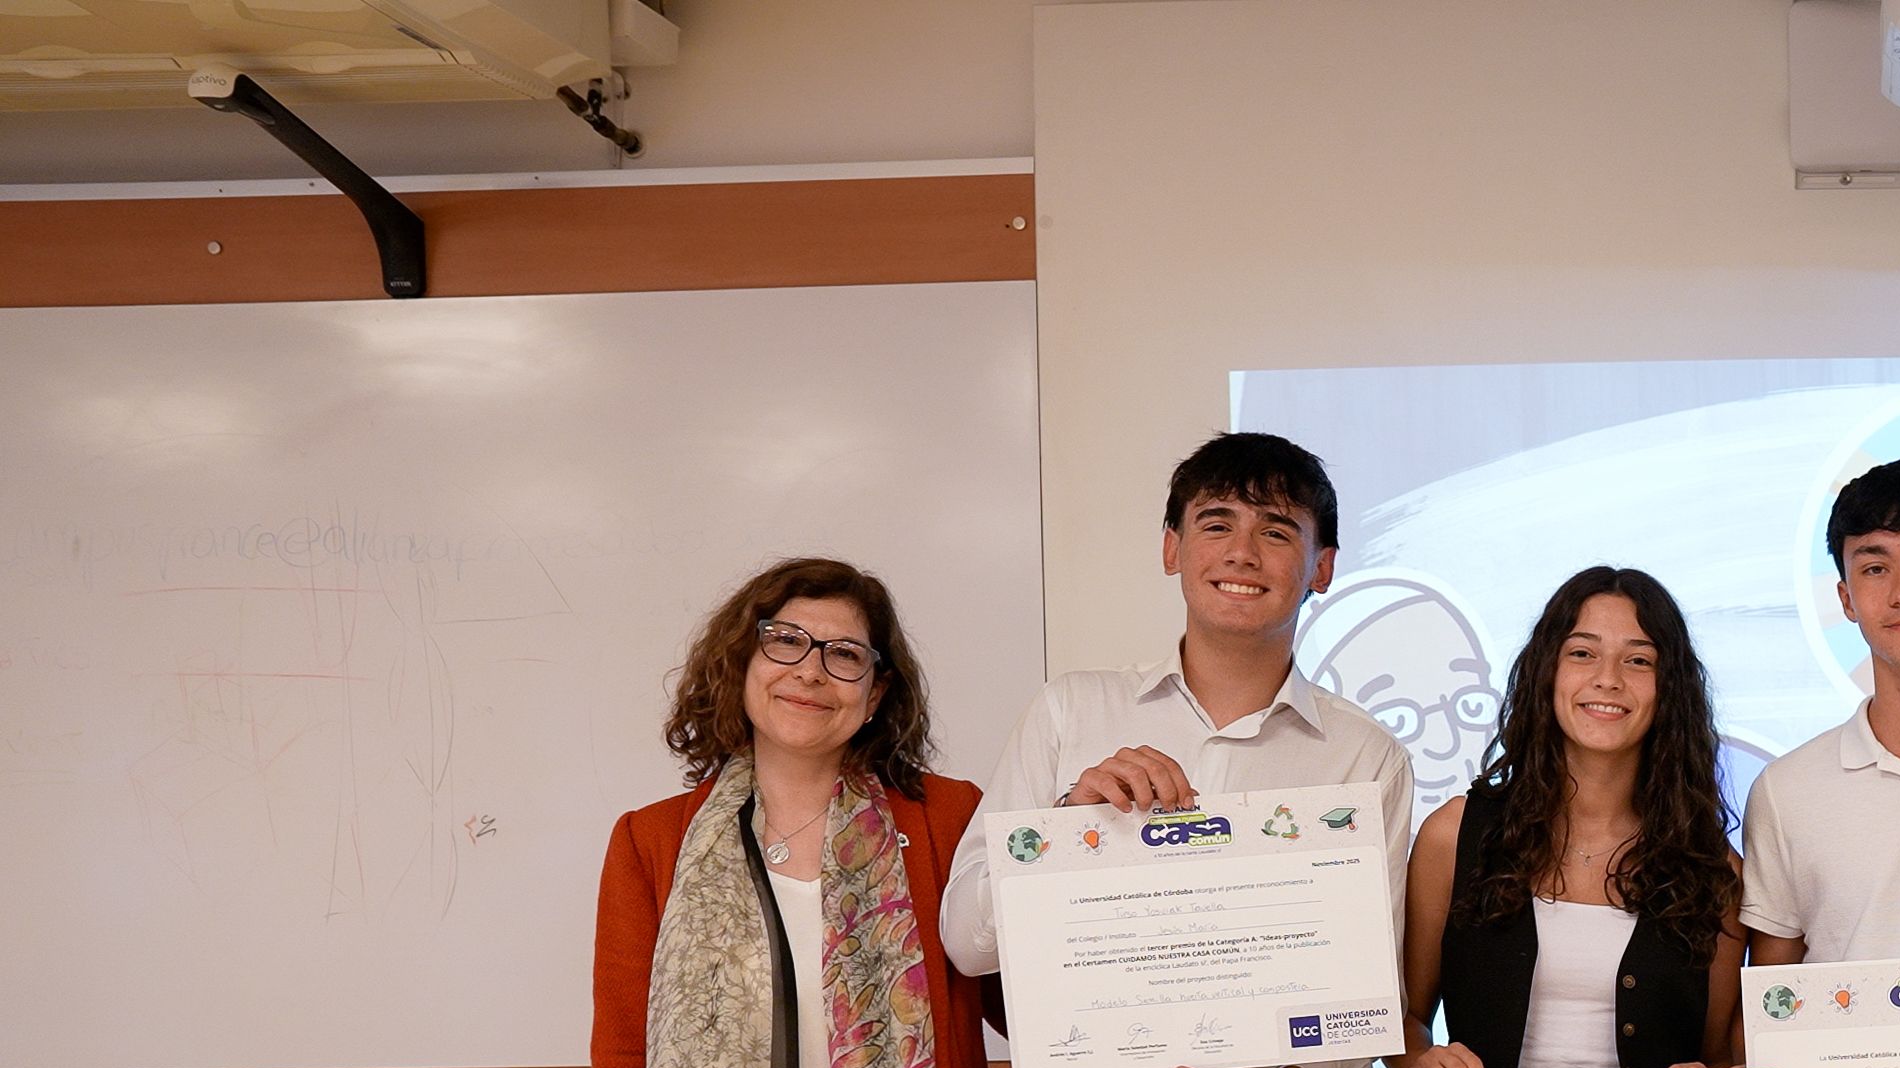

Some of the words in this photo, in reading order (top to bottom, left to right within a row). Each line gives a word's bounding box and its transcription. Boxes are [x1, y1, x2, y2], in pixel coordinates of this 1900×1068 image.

[1139, 815, 1231, 846] casa
[1188, 831, 1230, 845] común
[1312, 859, 1344, 868] Noviembre
[1079, 894, 1121, 903] Universidad
[1123, 891, 1151, 900] Católica
[1163, 887, 1193, 896] Córdoba
[1170, 941, 1195, 950] premio
[1215, 936, 1250, 947] Categoría
[1081, 958, 1117, 966] Certamen
[1118, 954, 1156, 963] CUIDAMOS
[1158, 951, 1190, 960] NUESTRA
[1191, 949, 1210, 957] CASA
[1325, 1008, 1388, 1021] UNIVERSIDAD
[1326, 1018, 1370, 1029] CATÓLICA
[1292, 1025, 1319, 1038] UCC
[1326, 1030, 1339, 1039] DE
[1341, 1025, 1387, 1037] CÓRDOBA
[1828, 1052, 1867, 1060] Universidad
